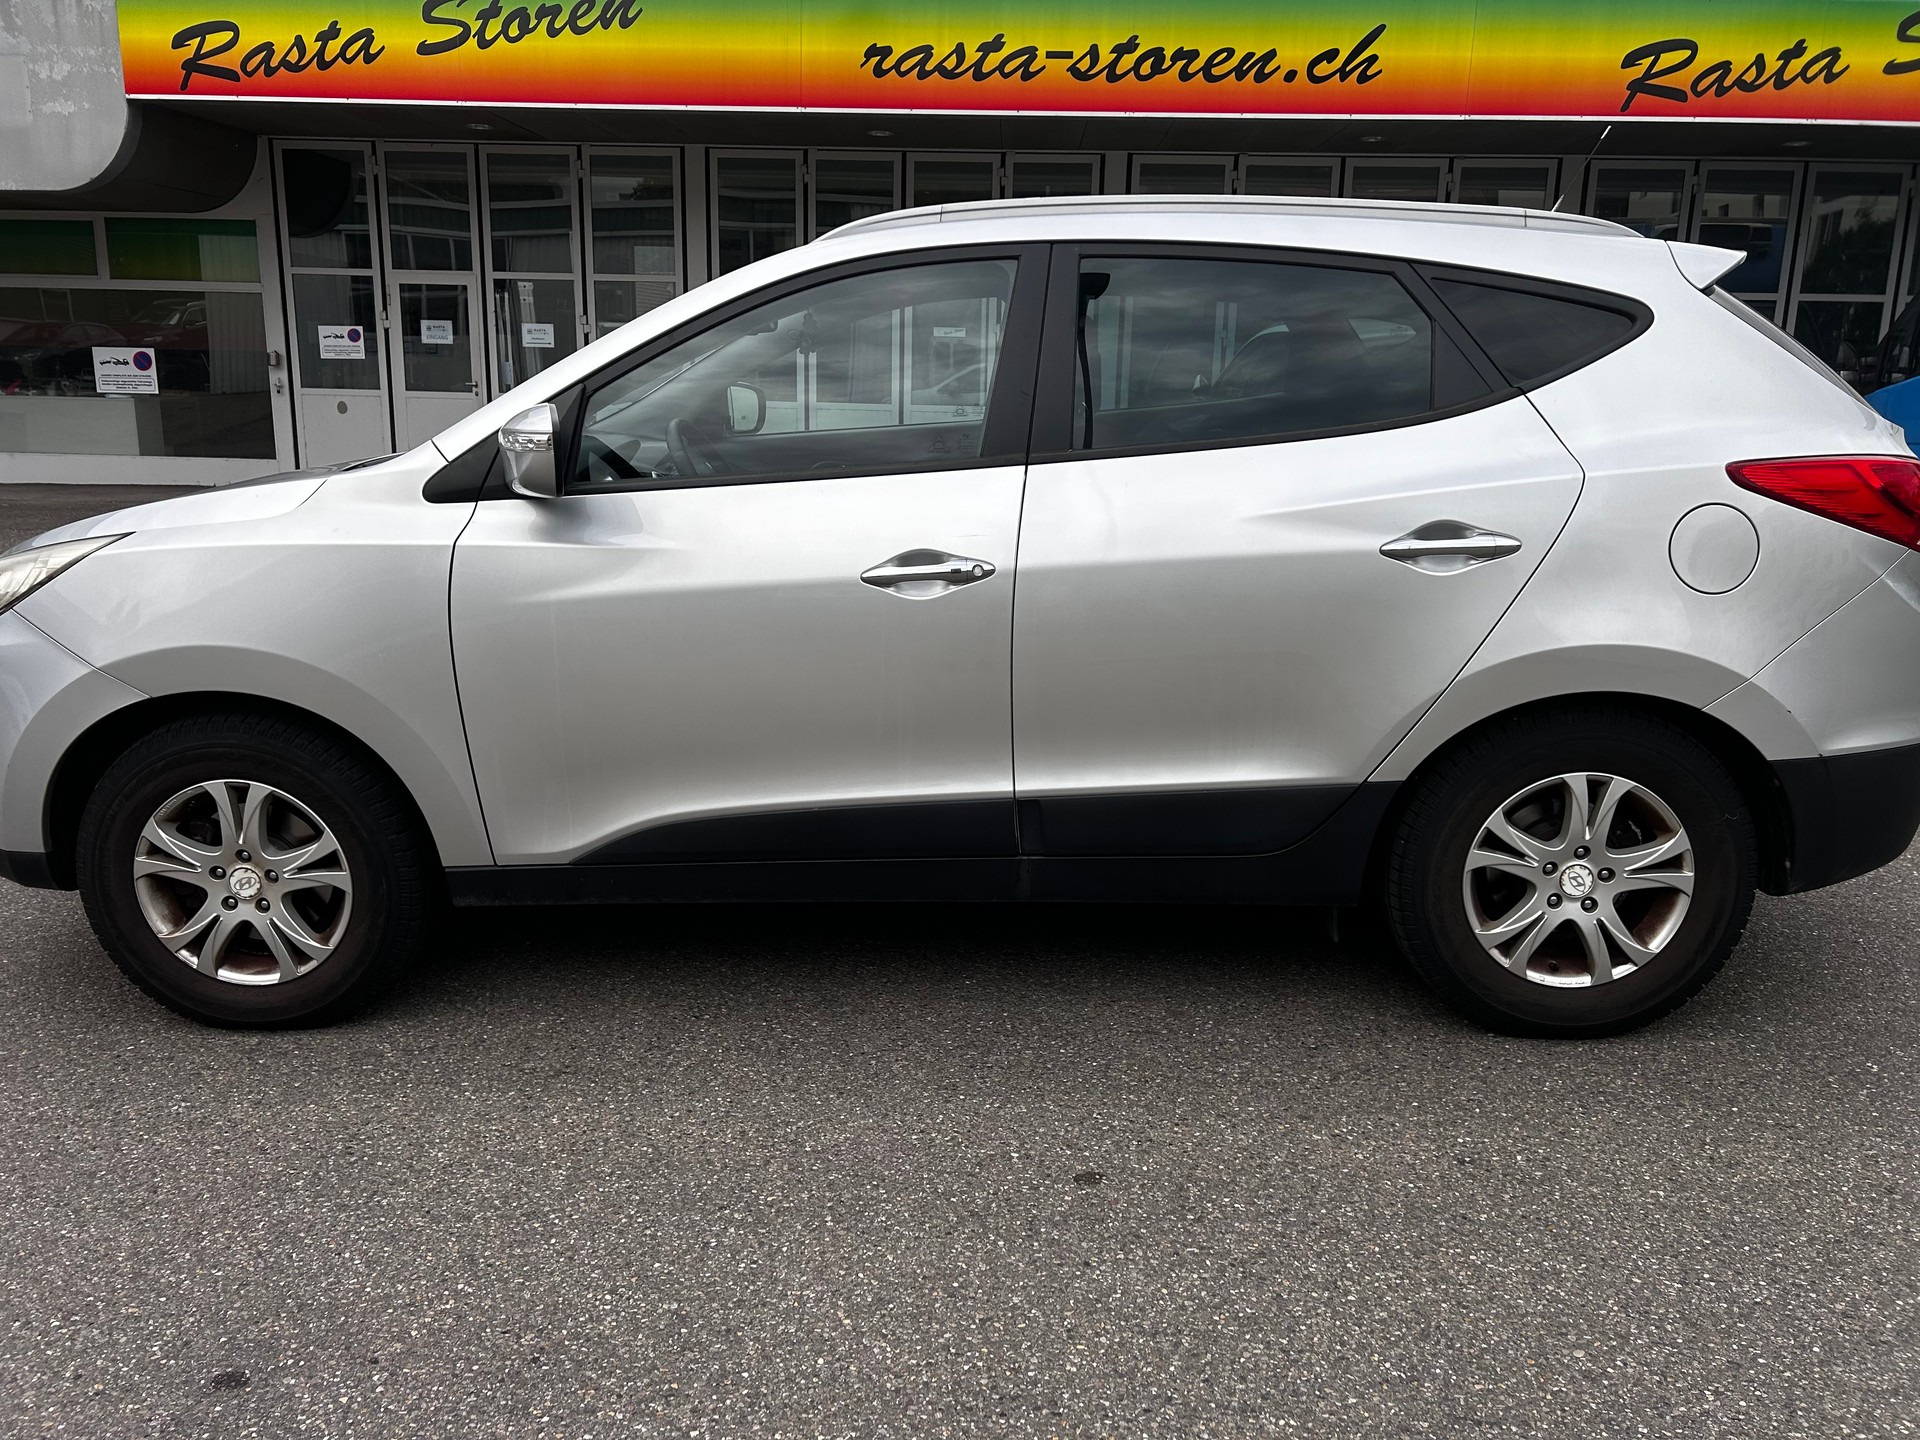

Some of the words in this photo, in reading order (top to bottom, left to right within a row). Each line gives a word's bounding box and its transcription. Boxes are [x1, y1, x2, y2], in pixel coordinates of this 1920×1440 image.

[172, 20, 386, 92] Rasta
[416, 0, 644, 56] Storen
[860, 23, 1387, 85] rasta-storen.ch
[1620, 38, 1850, 112] Rasta
